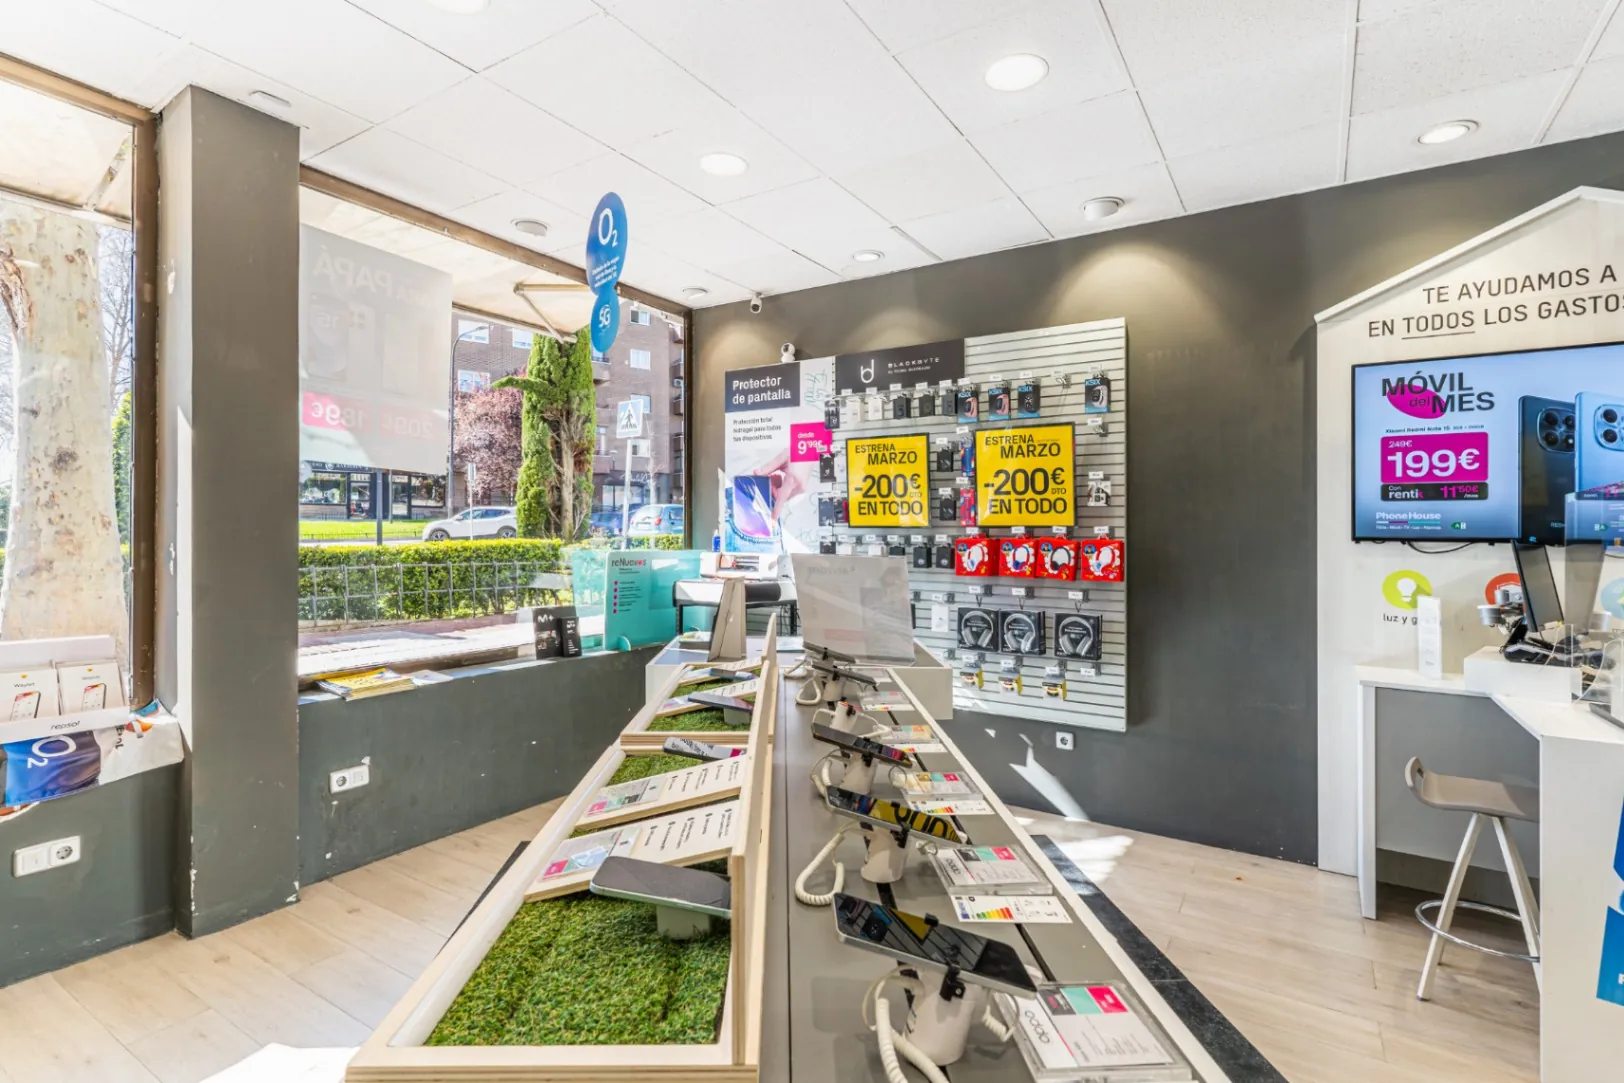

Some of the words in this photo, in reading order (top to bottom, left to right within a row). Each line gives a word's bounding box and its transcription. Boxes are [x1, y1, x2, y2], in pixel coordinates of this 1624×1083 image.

[1423, 285, 1450, 305] TE
[1457, 267, 1590, 301] AYUDAMOS
[1600, 264, 1617, 284] A
[1368, 319, 1395, 337] EN
[1402, 310, 1475, 334] TODOS
[1484, 304, 1528, 326] LOS
[1538, 294, 1624, 320] GASTO
[732, 377, 781, 391] Protector
[1381, 370, 1474, 397] MÓVIL
[732, 393, 745, 405] de
[747, 389, 791, 405] pantalla
[1409, 396, 1431, 408] del
[1431, 391, 1496, 414] MES
[984, 434, 1035, 446] ESTRENA
[855, 443, 897, 454] ESTRENA
[1000, 442, 1061, 459] MARZO
[867, 450, 918, 466] MARZO
[1387, 448, 1481, 478] 199€
[1051, 487, 1067, 495] DTO
[857, 501, 878, 516] EN
[880, 500, 924, 516] TODO
[988, 498, 1012, 515] EN
[1014, 497, 1068, 515] TODO
[1383, 613, 1399, 623] luz
[1402, 616, 1408, 625] y
